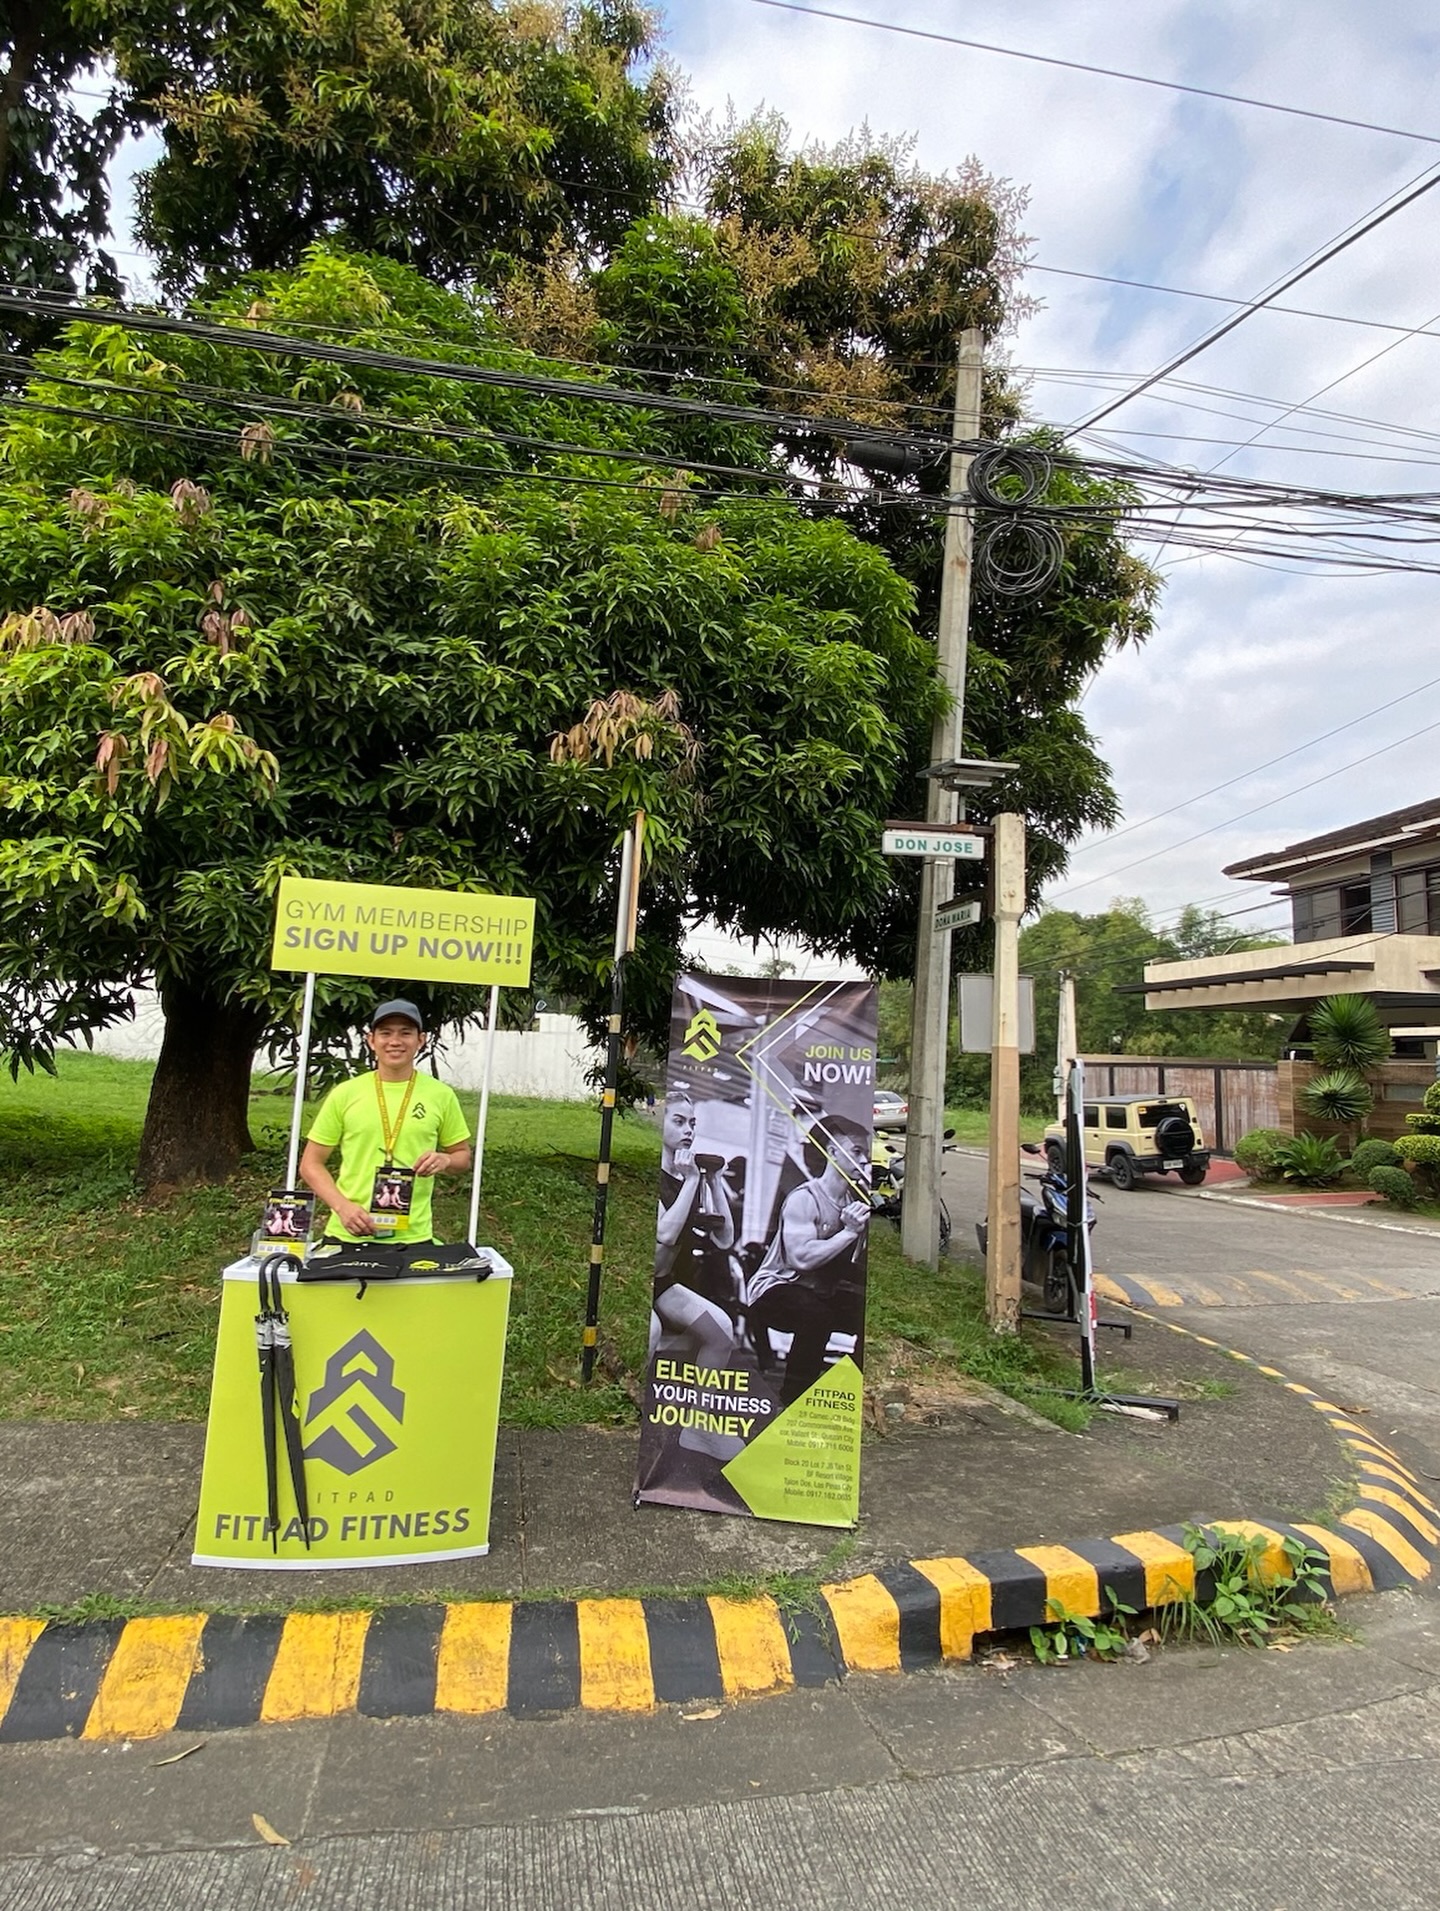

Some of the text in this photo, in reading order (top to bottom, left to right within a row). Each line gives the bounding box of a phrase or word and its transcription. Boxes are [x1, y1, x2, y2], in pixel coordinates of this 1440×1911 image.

[895, 838, 973, 854] DON JOSE
[286, 900, 528, 936] GYM MEMBERSHIP
[952, 909, 970, 923] MARIA
[284, 926, 523, 965] SIGN UP NOW!!!
[805, 1045, 872, 1062] JOIN US
[804, 1062, 872, 1085] NOW!
[656, 1360, 749, 1391] ELEVATE
[653, 1383, 771, 1414] YOUR FITNESS
[814, 1388, 855, 1401] FITPAD
[806, 1398, 855, 1411] FITNESS
[649, 1404, 755, 1437] JOURNEY
[798, 1421, 842, 1431] Commonwealth
[844, 1435, 854, 1444] City
[815, 1471, 834, 1479] Resort
[835, 1474, 853, 1482] Village
[842, 1484, 852, 1492] City
[316, 1490, 395, 1504] ITPAD
[340, 1507, 470, 1541] FITNESS
